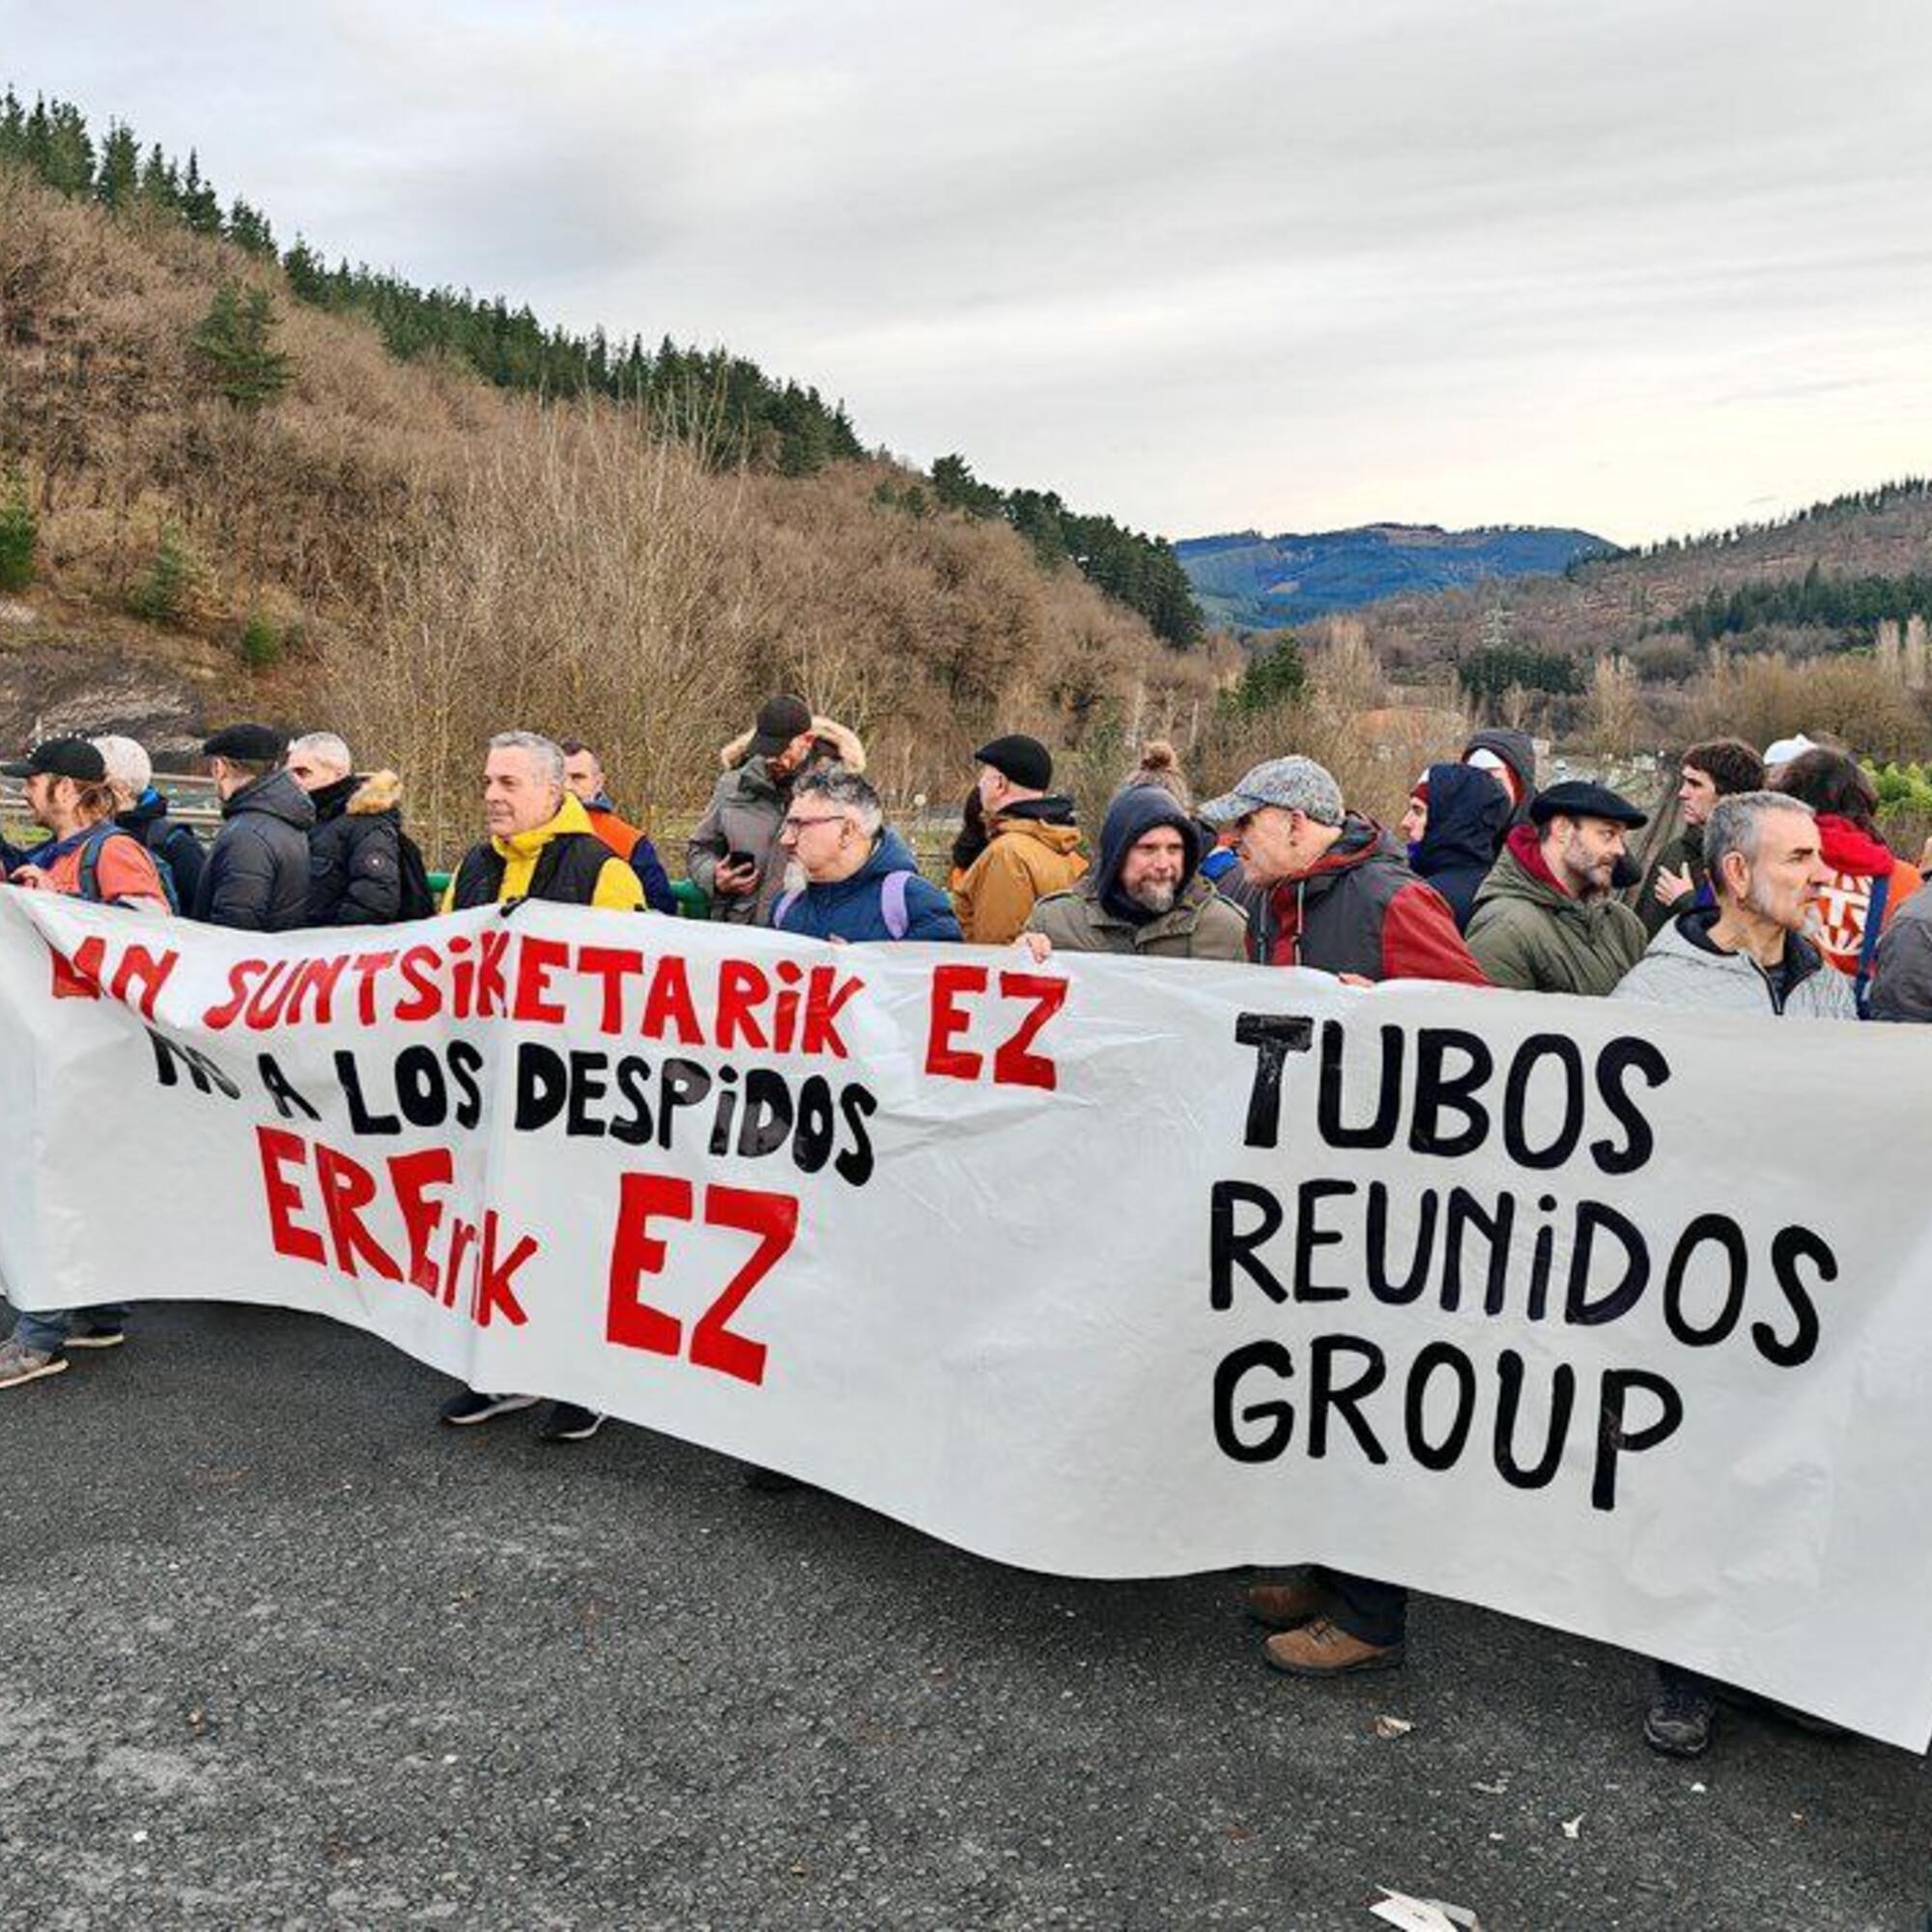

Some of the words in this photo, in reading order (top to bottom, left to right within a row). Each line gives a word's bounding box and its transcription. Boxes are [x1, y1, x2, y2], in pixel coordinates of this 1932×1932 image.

[257, 1052, 323, 1122] A
[333, 1038, 484, 1136] LOS
[924, 963, 1068, 1091] EZ
[1235, 1011, 1671, 1176] TUBOS
[604, 1170, 801, 1386] EZ
[1212, 1333, 1684, 1512] GROUP
